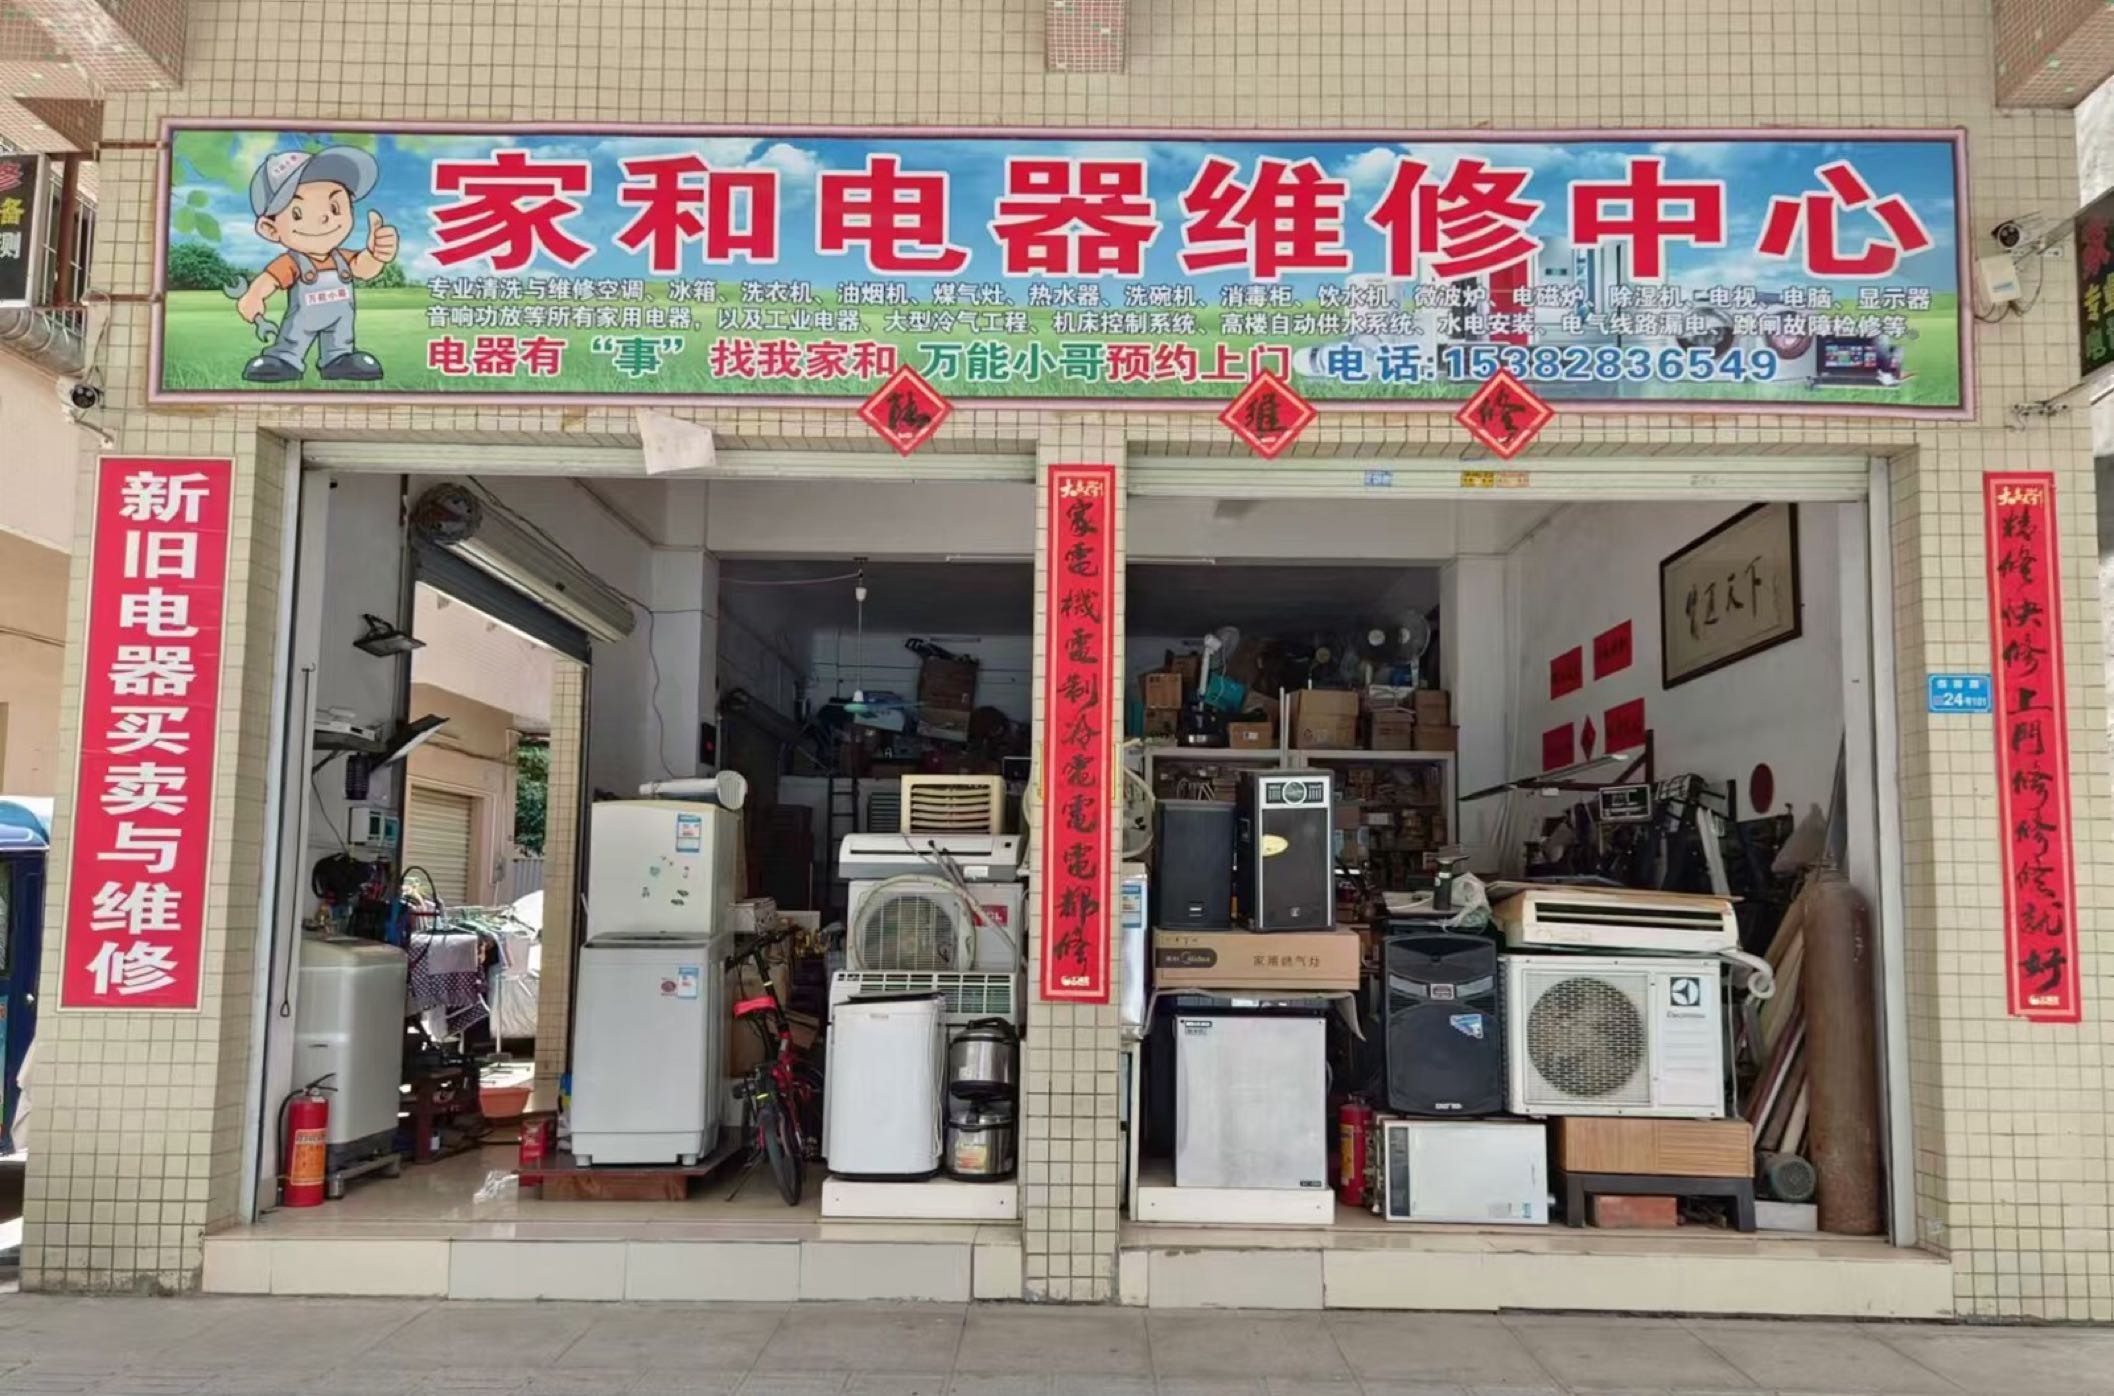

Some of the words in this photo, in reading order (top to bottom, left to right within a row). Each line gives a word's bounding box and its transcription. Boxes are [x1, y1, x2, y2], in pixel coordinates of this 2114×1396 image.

[429, 152, 1933, 277] 家和电器维修中心
[427, 335, 566, 377] 电器有
[710, 338, 898, 381] 找我家和
[919, 342, 1292, 383] 万能小哥预约上门
[85, 471, 210, 997] 新旧电器买卖与维修
